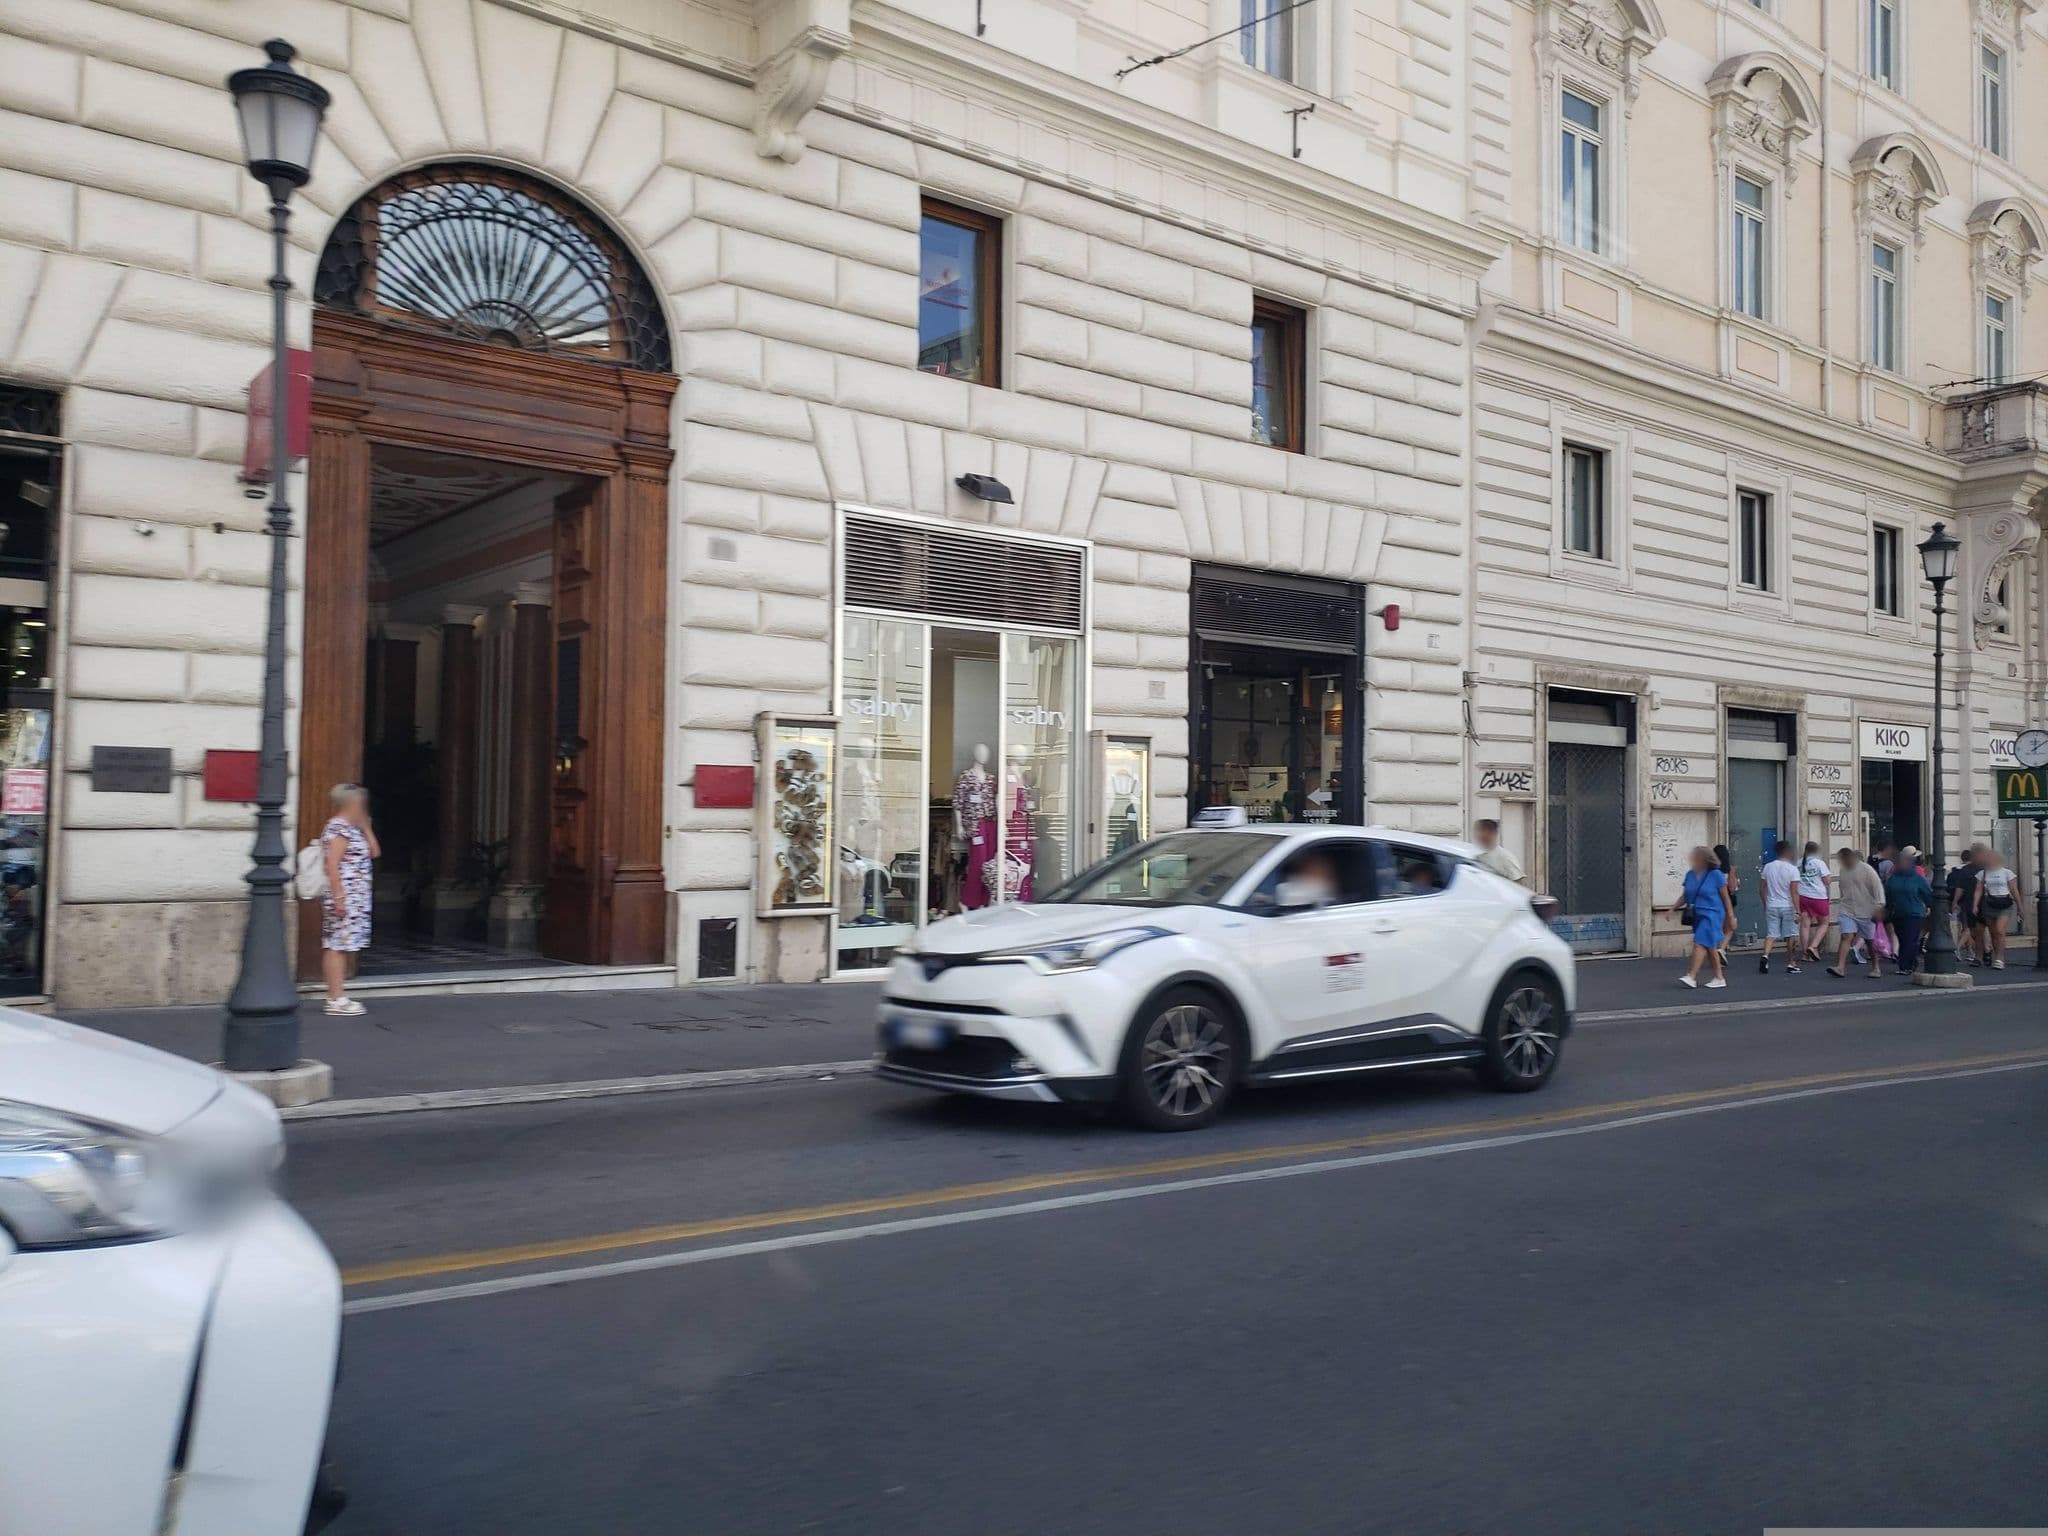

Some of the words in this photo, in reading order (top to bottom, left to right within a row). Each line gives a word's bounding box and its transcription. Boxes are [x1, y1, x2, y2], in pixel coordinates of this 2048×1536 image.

[849, 694, 914, 723] sabry
[1013, 705, 1068, 730] sabry
[1875, 727, 1910, 748] KIKO
[1302, 809, 1338, 818] SUMMER
